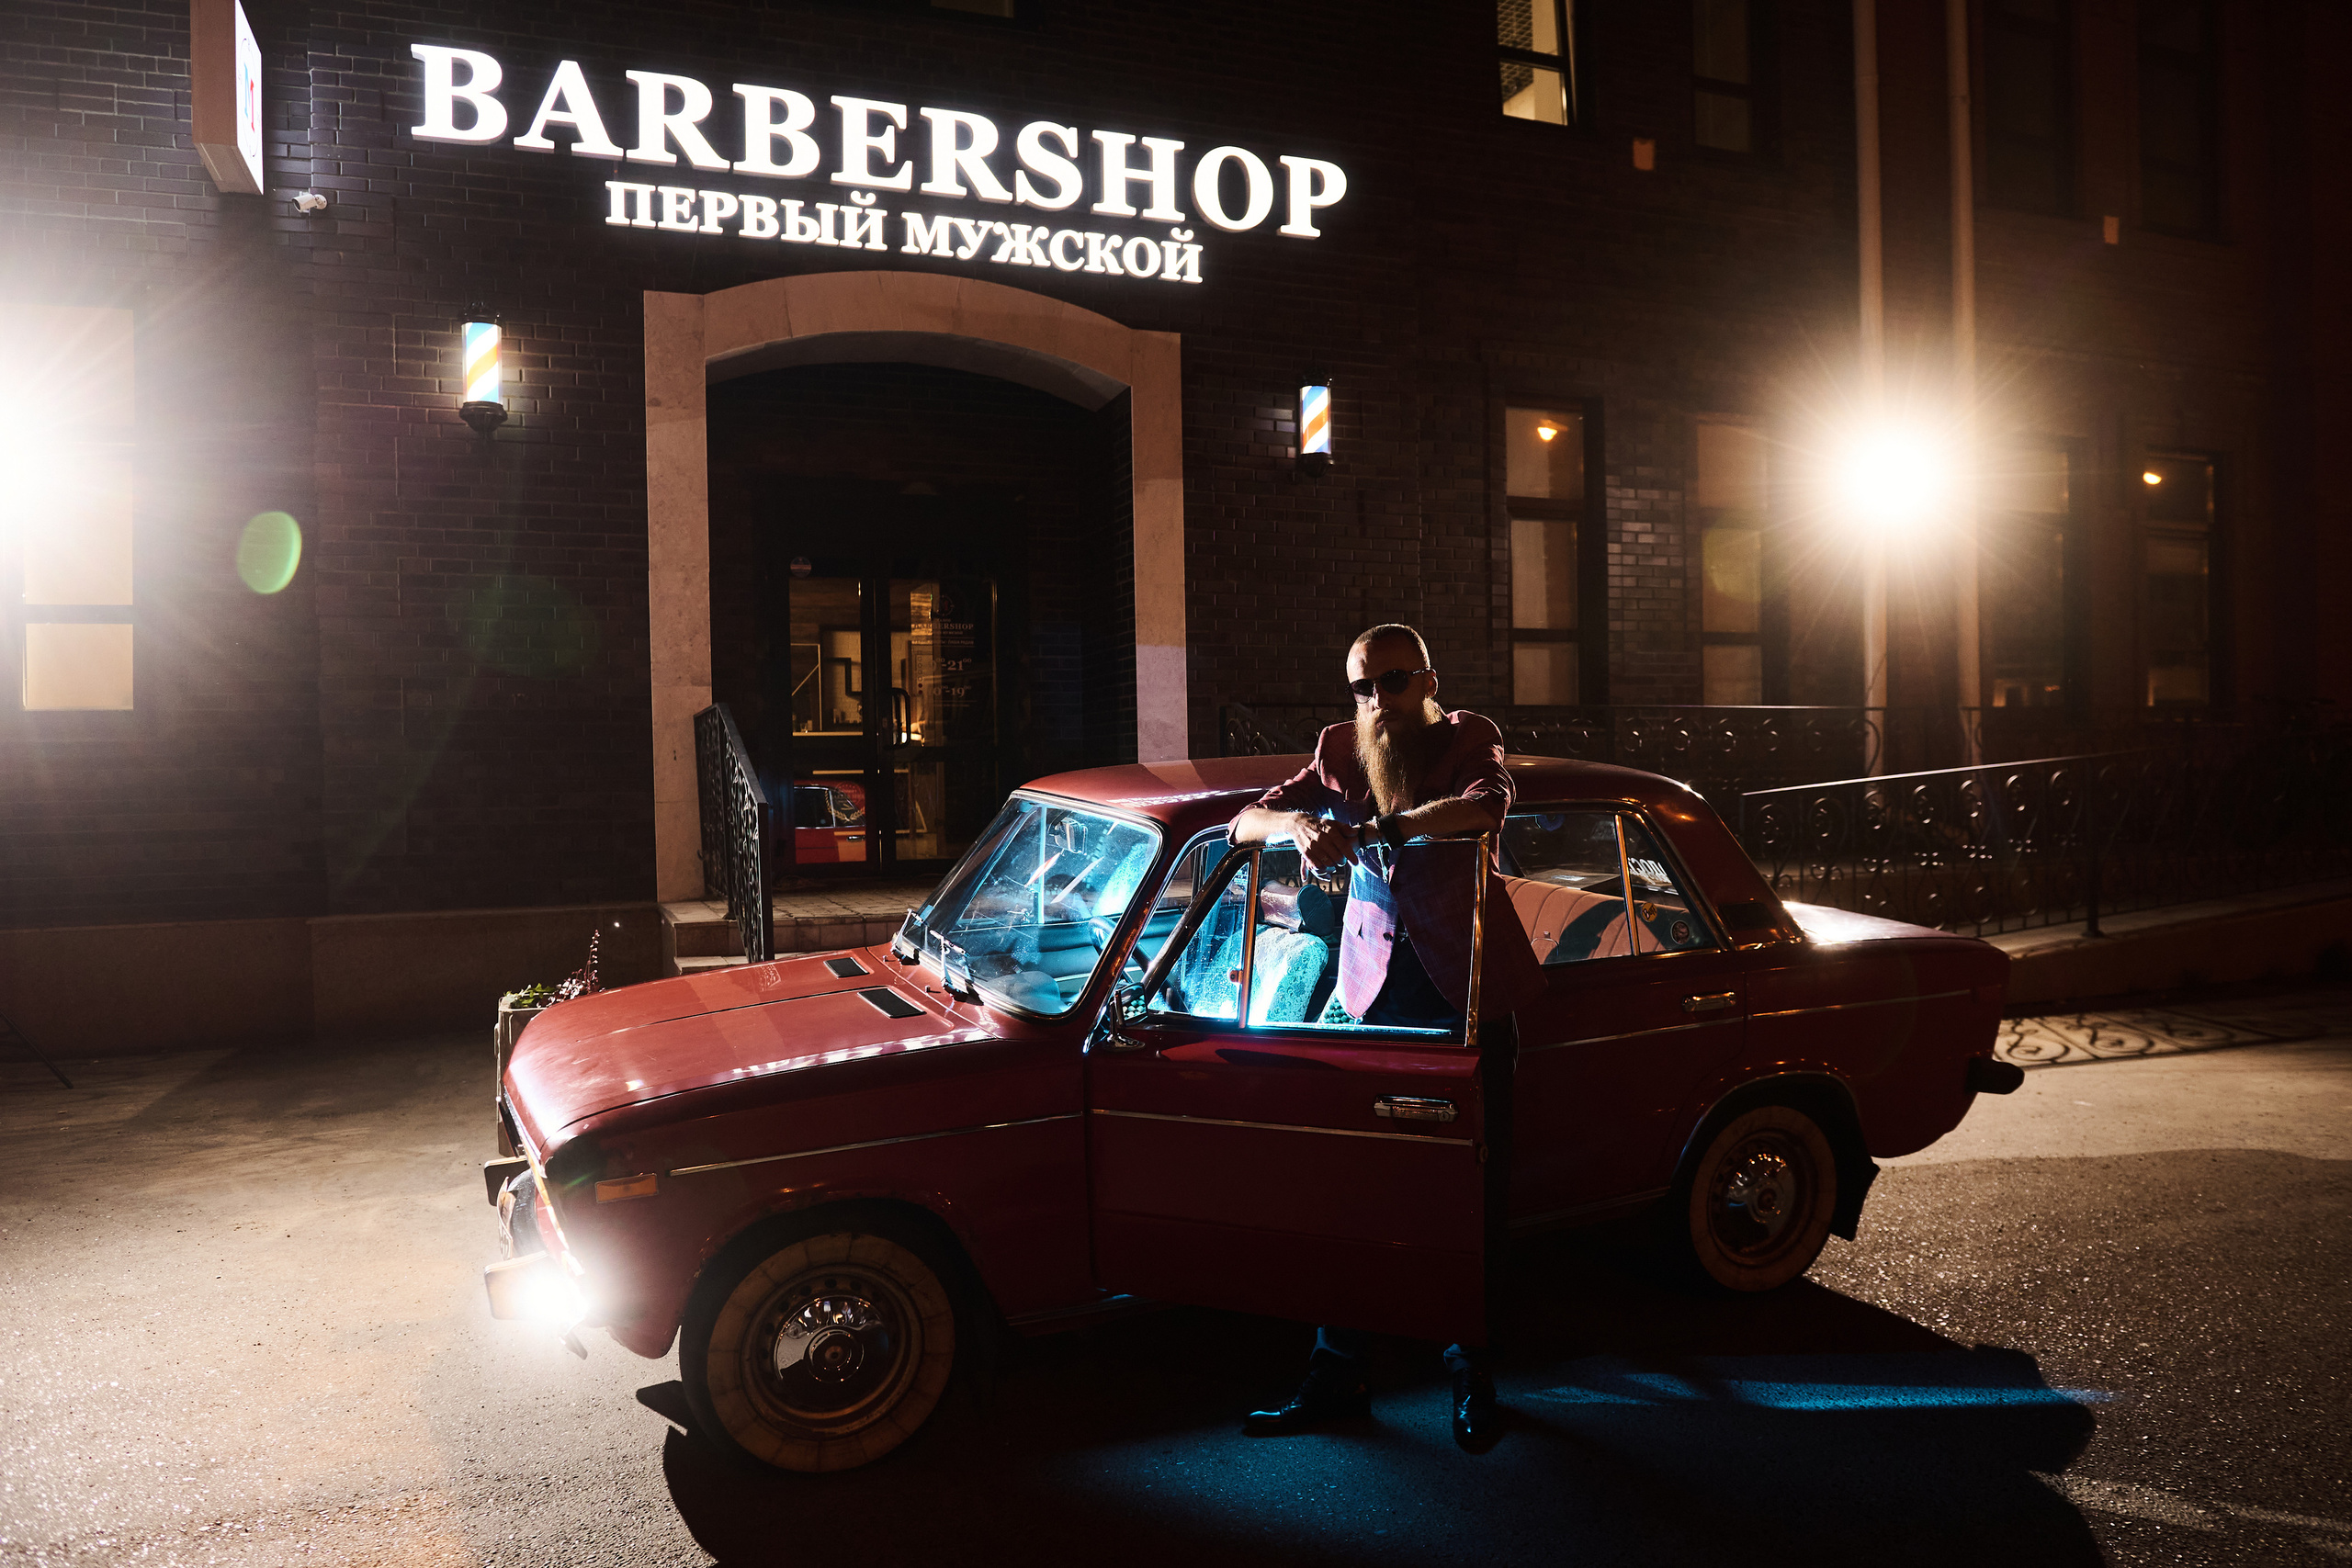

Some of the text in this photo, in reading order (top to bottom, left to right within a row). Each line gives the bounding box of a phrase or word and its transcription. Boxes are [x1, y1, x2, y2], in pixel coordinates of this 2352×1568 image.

[410, 43, 1348, 239] BARBERSHOP
[605, 180, 1204, 284] ПЕРВЫЙ МУЖСКОЙ
